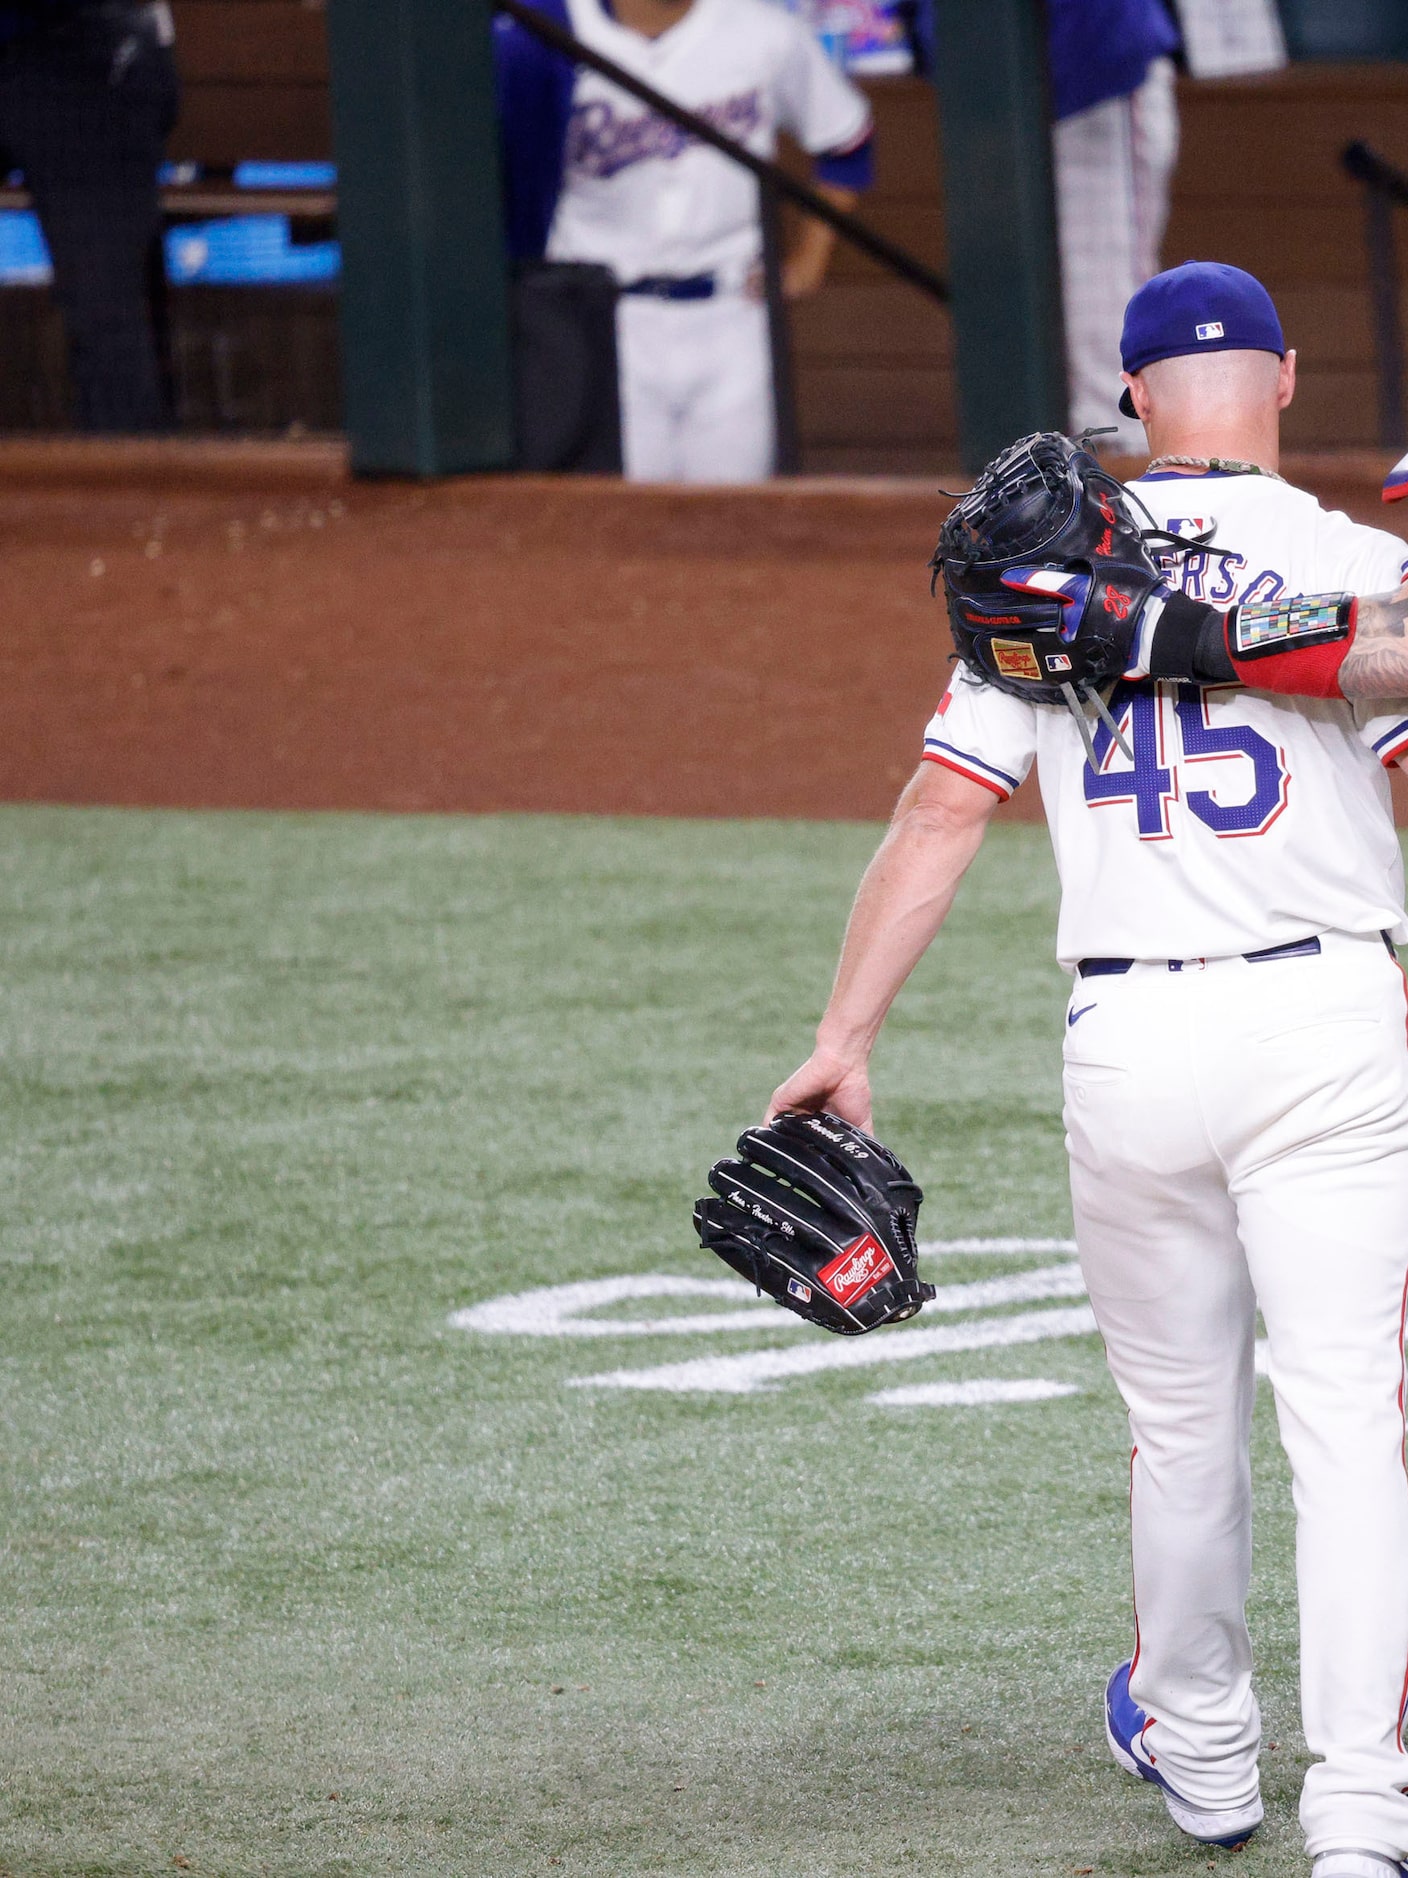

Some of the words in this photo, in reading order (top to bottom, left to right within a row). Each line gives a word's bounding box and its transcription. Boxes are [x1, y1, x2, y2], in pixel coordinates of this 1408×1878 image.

[1153, 549, 1304, 605] ERSO
[1103, 583, 1132, 619] 28
[1083, 683, 1292, 841] 45
[840, 1141, 870, 1159] 16:9
[833, 1246, 876, 1293] Rawlings
